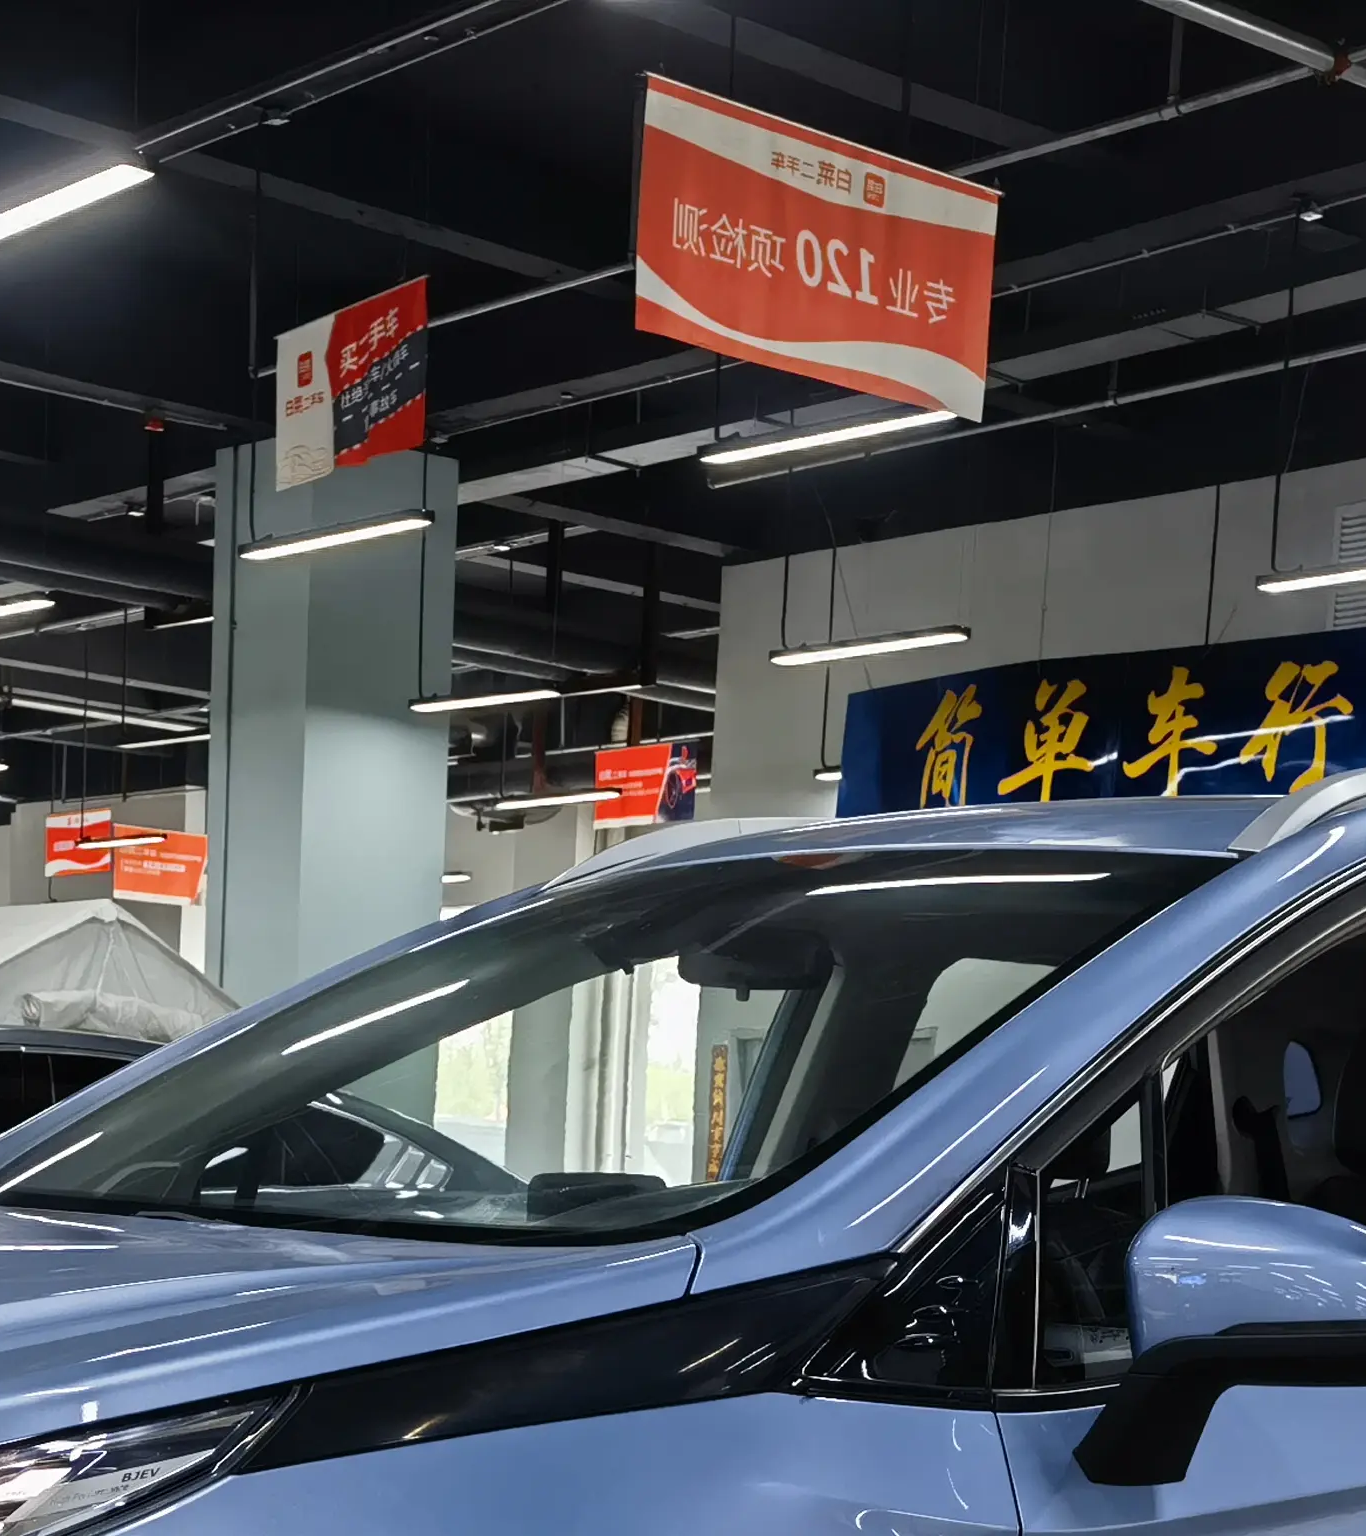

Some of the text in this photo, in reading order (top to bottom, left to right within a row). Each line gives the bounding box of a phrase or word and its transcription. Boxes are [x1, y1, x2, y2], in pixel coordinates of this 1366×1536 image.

[339, 307, 399, 378] 买二手车
[915, 660, 1354, 808] 简单车行
[121, 1467, 161, 1483] BJEV
